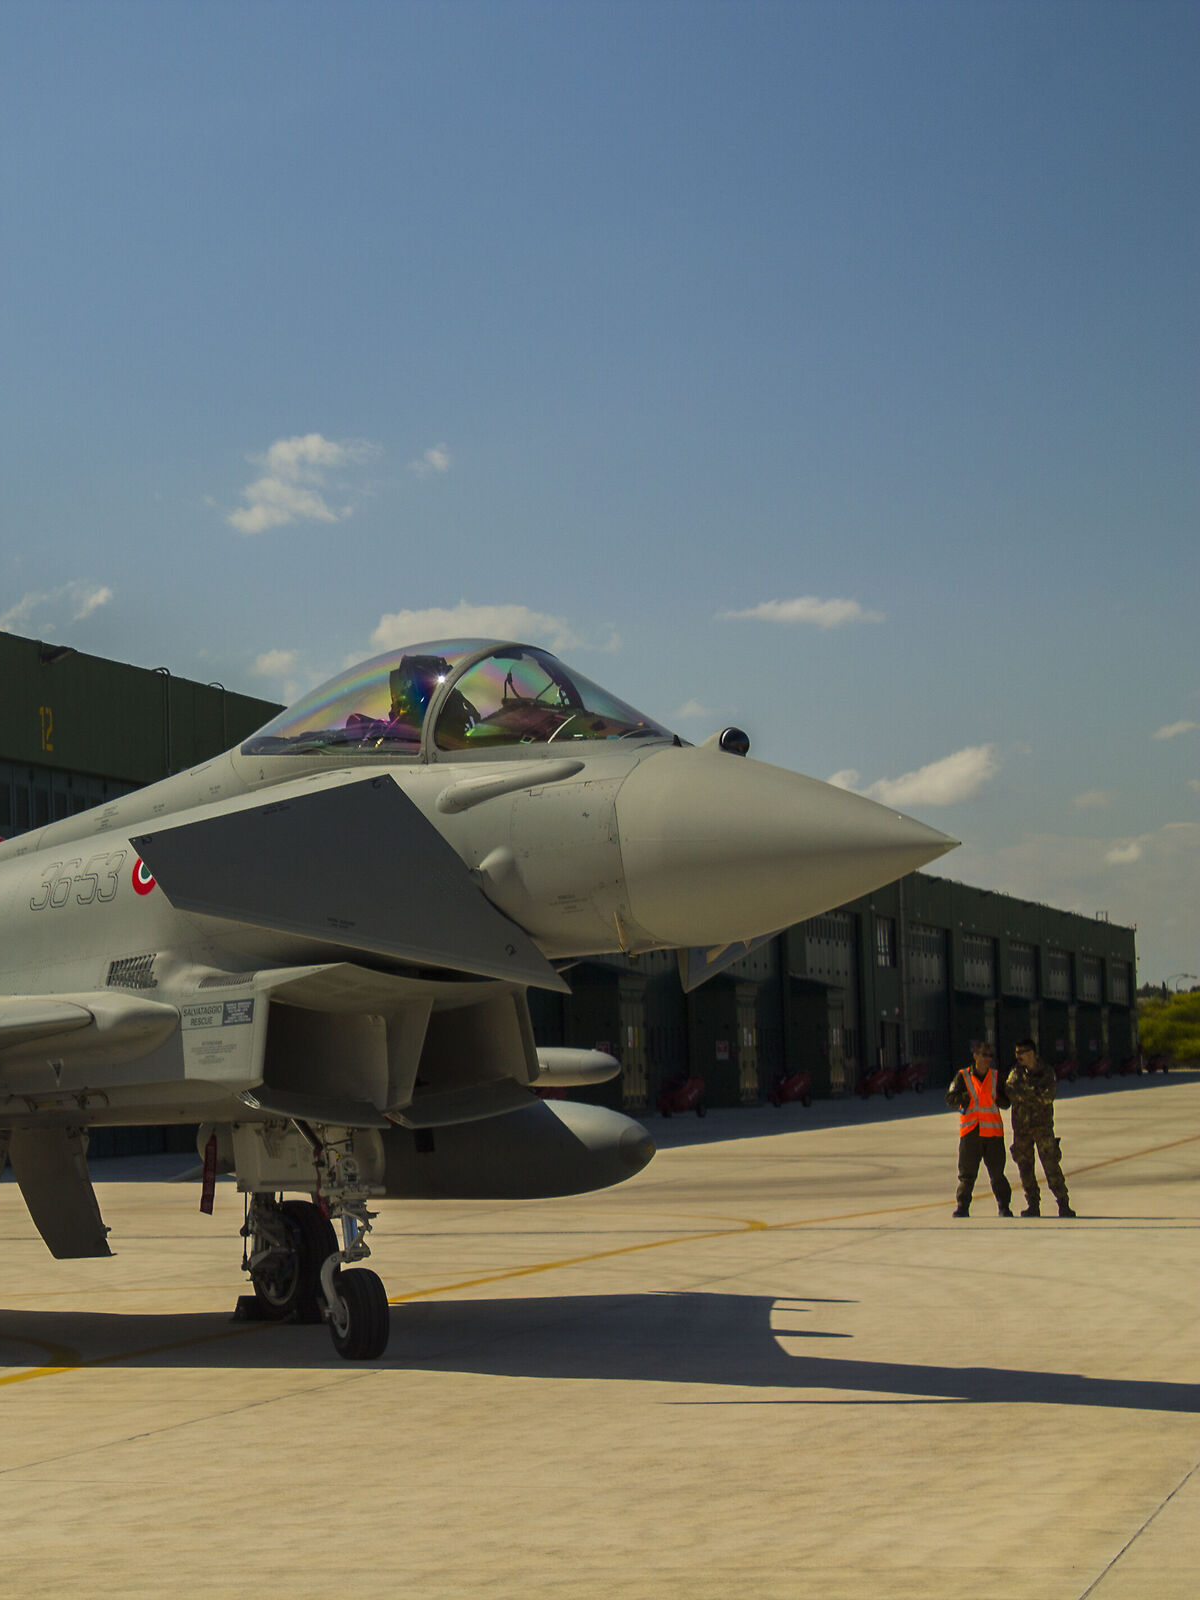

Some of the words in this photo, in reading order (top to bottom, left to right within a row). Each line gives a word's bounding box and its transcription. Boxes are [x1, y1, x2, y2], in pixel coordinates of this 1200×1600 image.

[39, 706, 54, 751] 12
[183, 1005, 223, 1017] SALVATAGGIO
[190, 1016, 214, 1026] RESCUE
